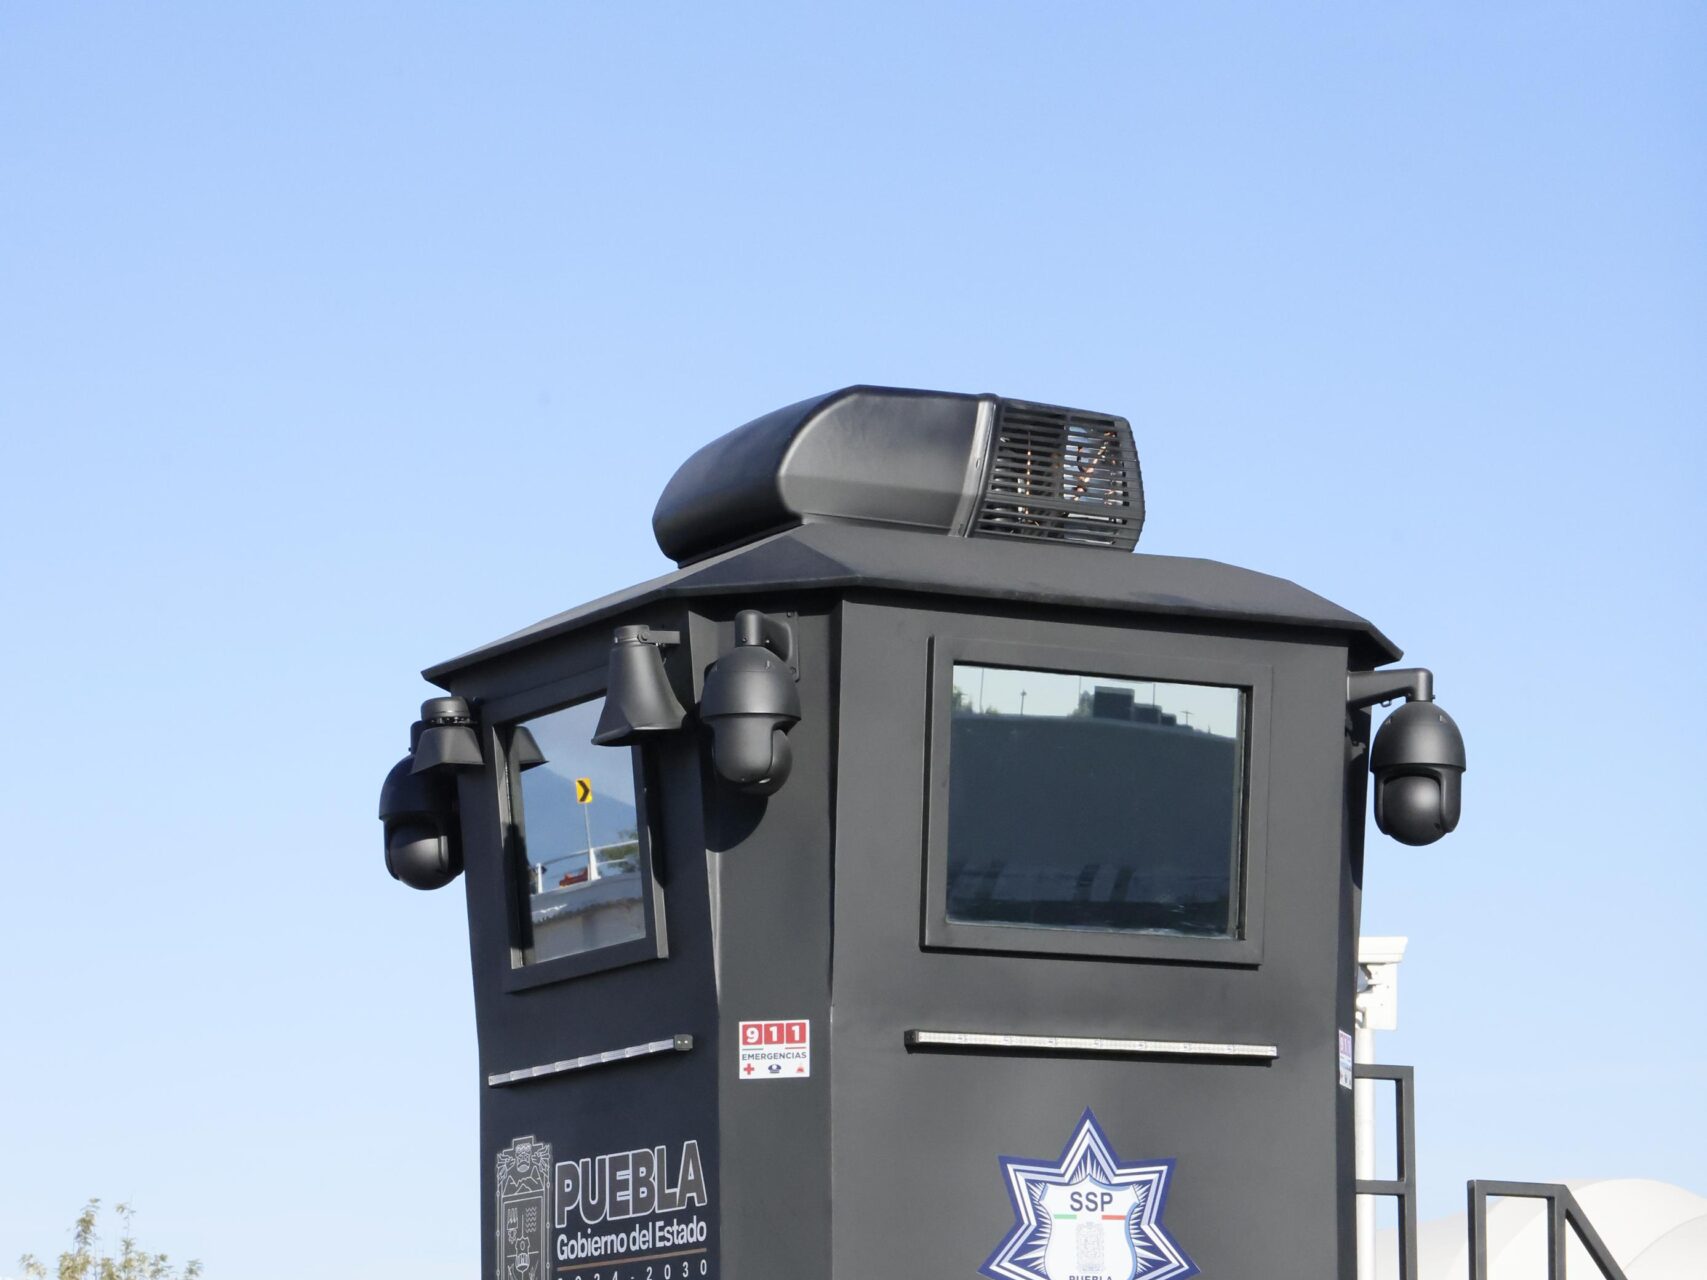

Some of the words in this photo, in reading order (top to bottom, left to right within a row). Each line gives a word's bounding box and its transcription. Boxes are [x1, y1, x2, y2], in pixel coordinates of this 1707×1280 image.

[745, 1023, 803, 1044] 911
[741, 1050, 807, 1061] EMERGENCIAS
[555, 1140, 707, 1228] PUEBLA
[1069, 1191, 1113, 1212] SSP
[557, 1229, 627, 1261] Gobierno
[630, 1222, 652, 1250] del
[655, 1215, 707, 1247] Estado
